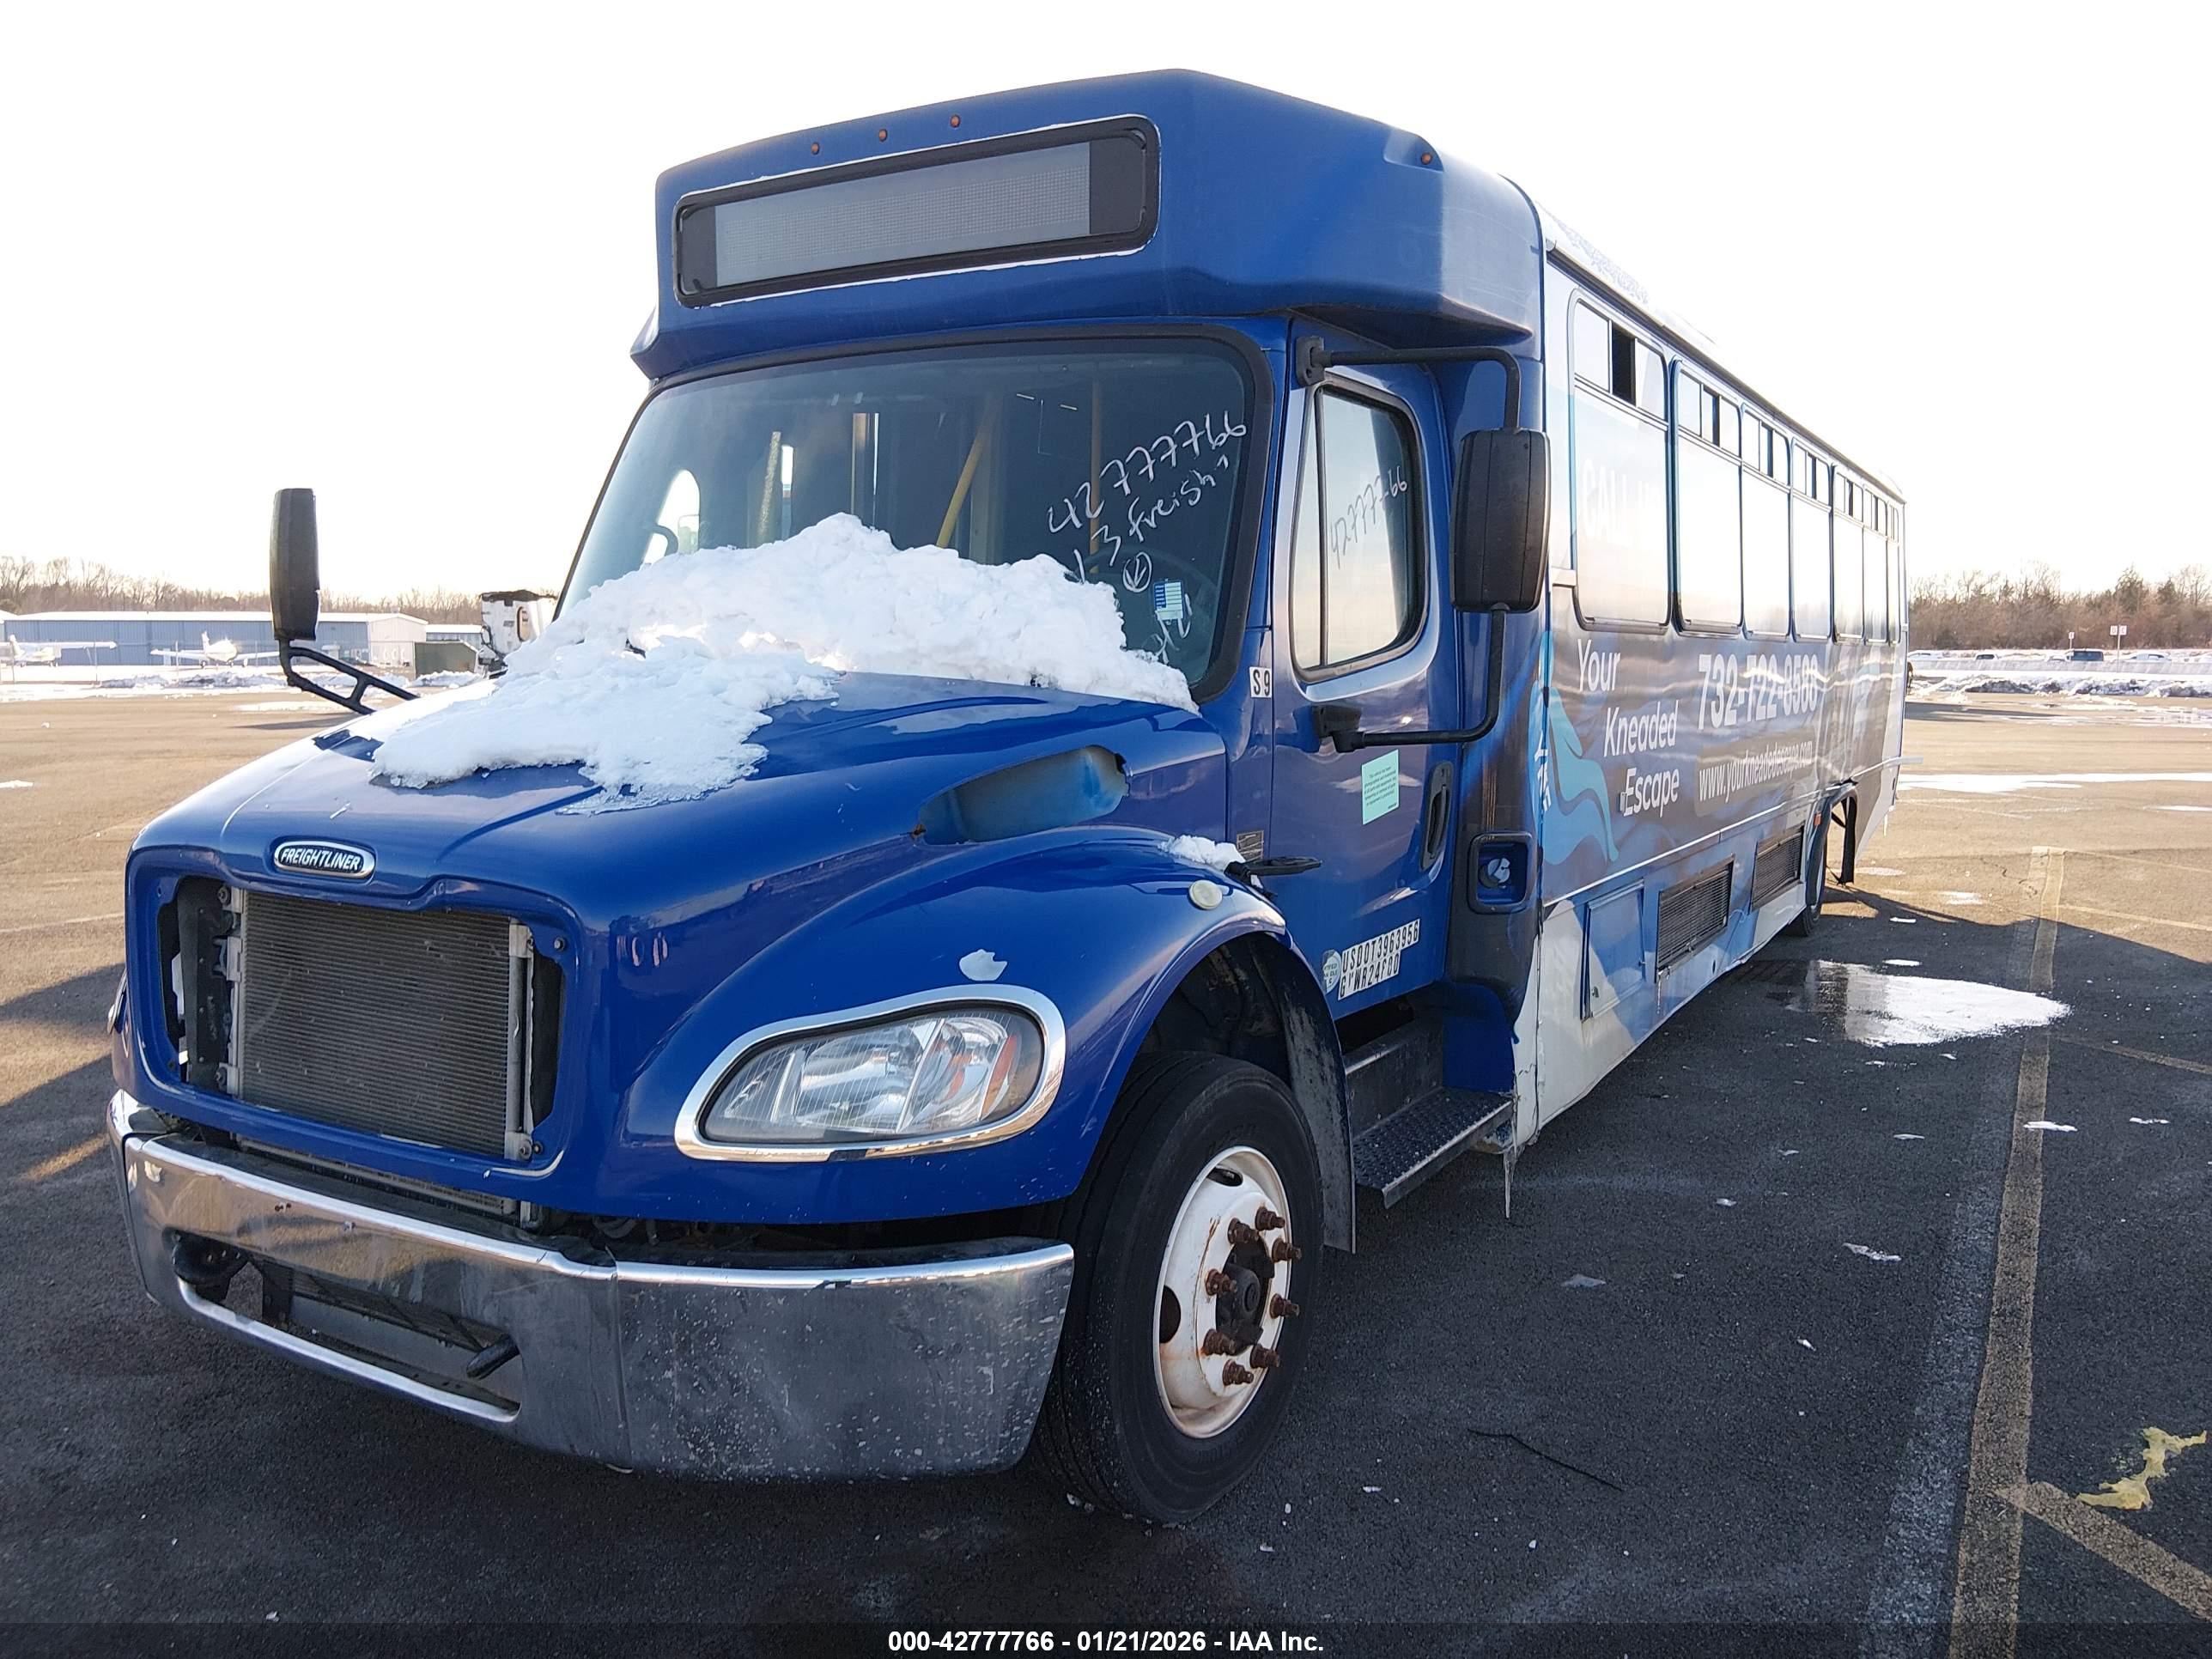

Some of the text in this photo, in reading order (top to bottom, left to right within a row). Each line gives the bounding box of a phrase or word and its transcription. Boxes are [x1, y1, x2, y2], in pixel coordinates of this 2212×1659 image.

[1048, 410, 1246, 533] 42777766
[1252, 669, 1270, 696] S9
[1577, 638, 1621, 692] Your
[1603, 699, 1679, 757] Kneaded
[1623, 767, 1680, 818] Escape
[281, 848, 362, 871] FREIGHTLINER
[1342, 920, 1419, 973] USDOT3963956
